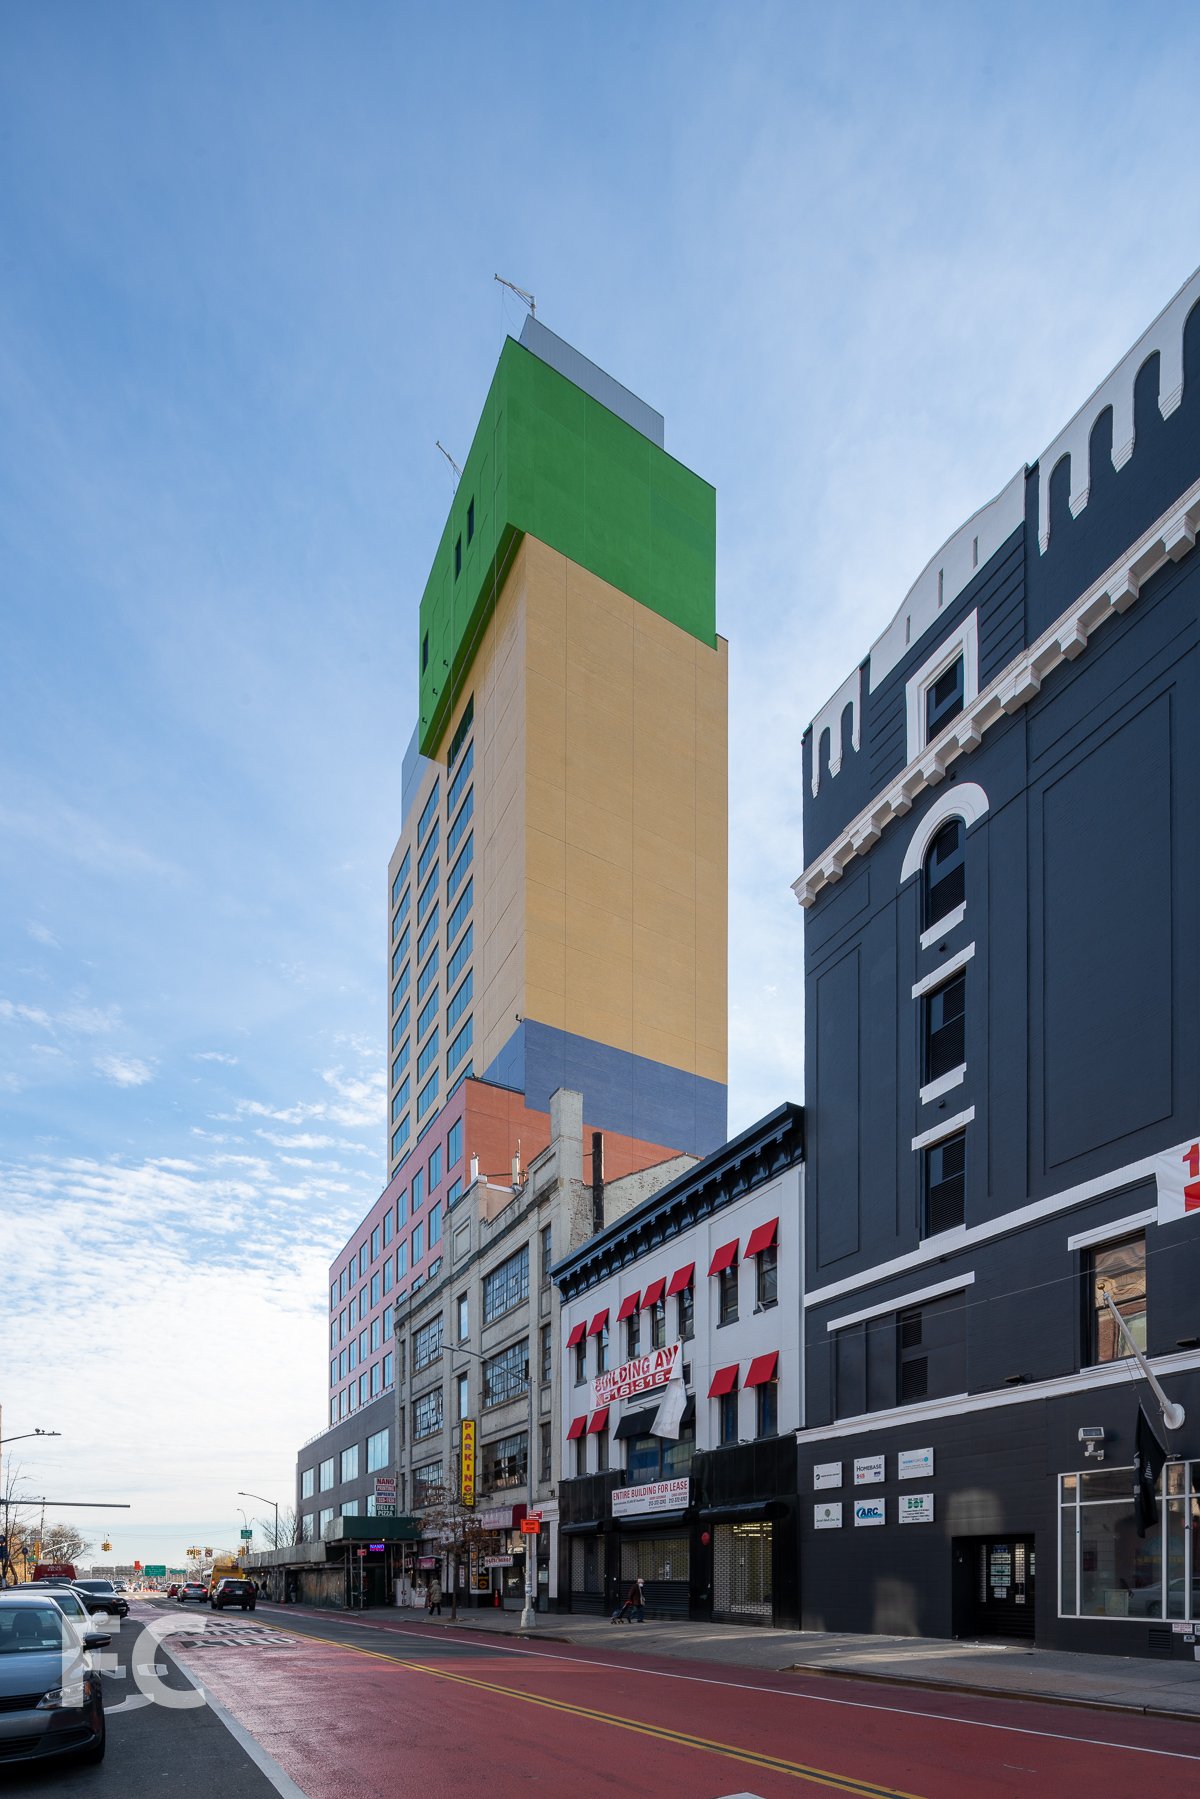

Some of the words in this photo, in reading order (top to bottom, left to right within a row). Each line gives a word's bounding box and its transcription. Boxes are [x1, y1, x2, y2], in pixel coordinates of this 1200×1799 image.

[595, 1357, 650, 1392] BUILDING
[463, 1422, 473, 1492] PARKING
[613, 1489, 630, 1501] ENTIRE
[631, 1485, 657, 1498] BUILDING
[657, 1483, 669, 1494] FOR
[669, 1480, 688, 1492] LEASE
[860, 1507, 879, 1516] ARC
